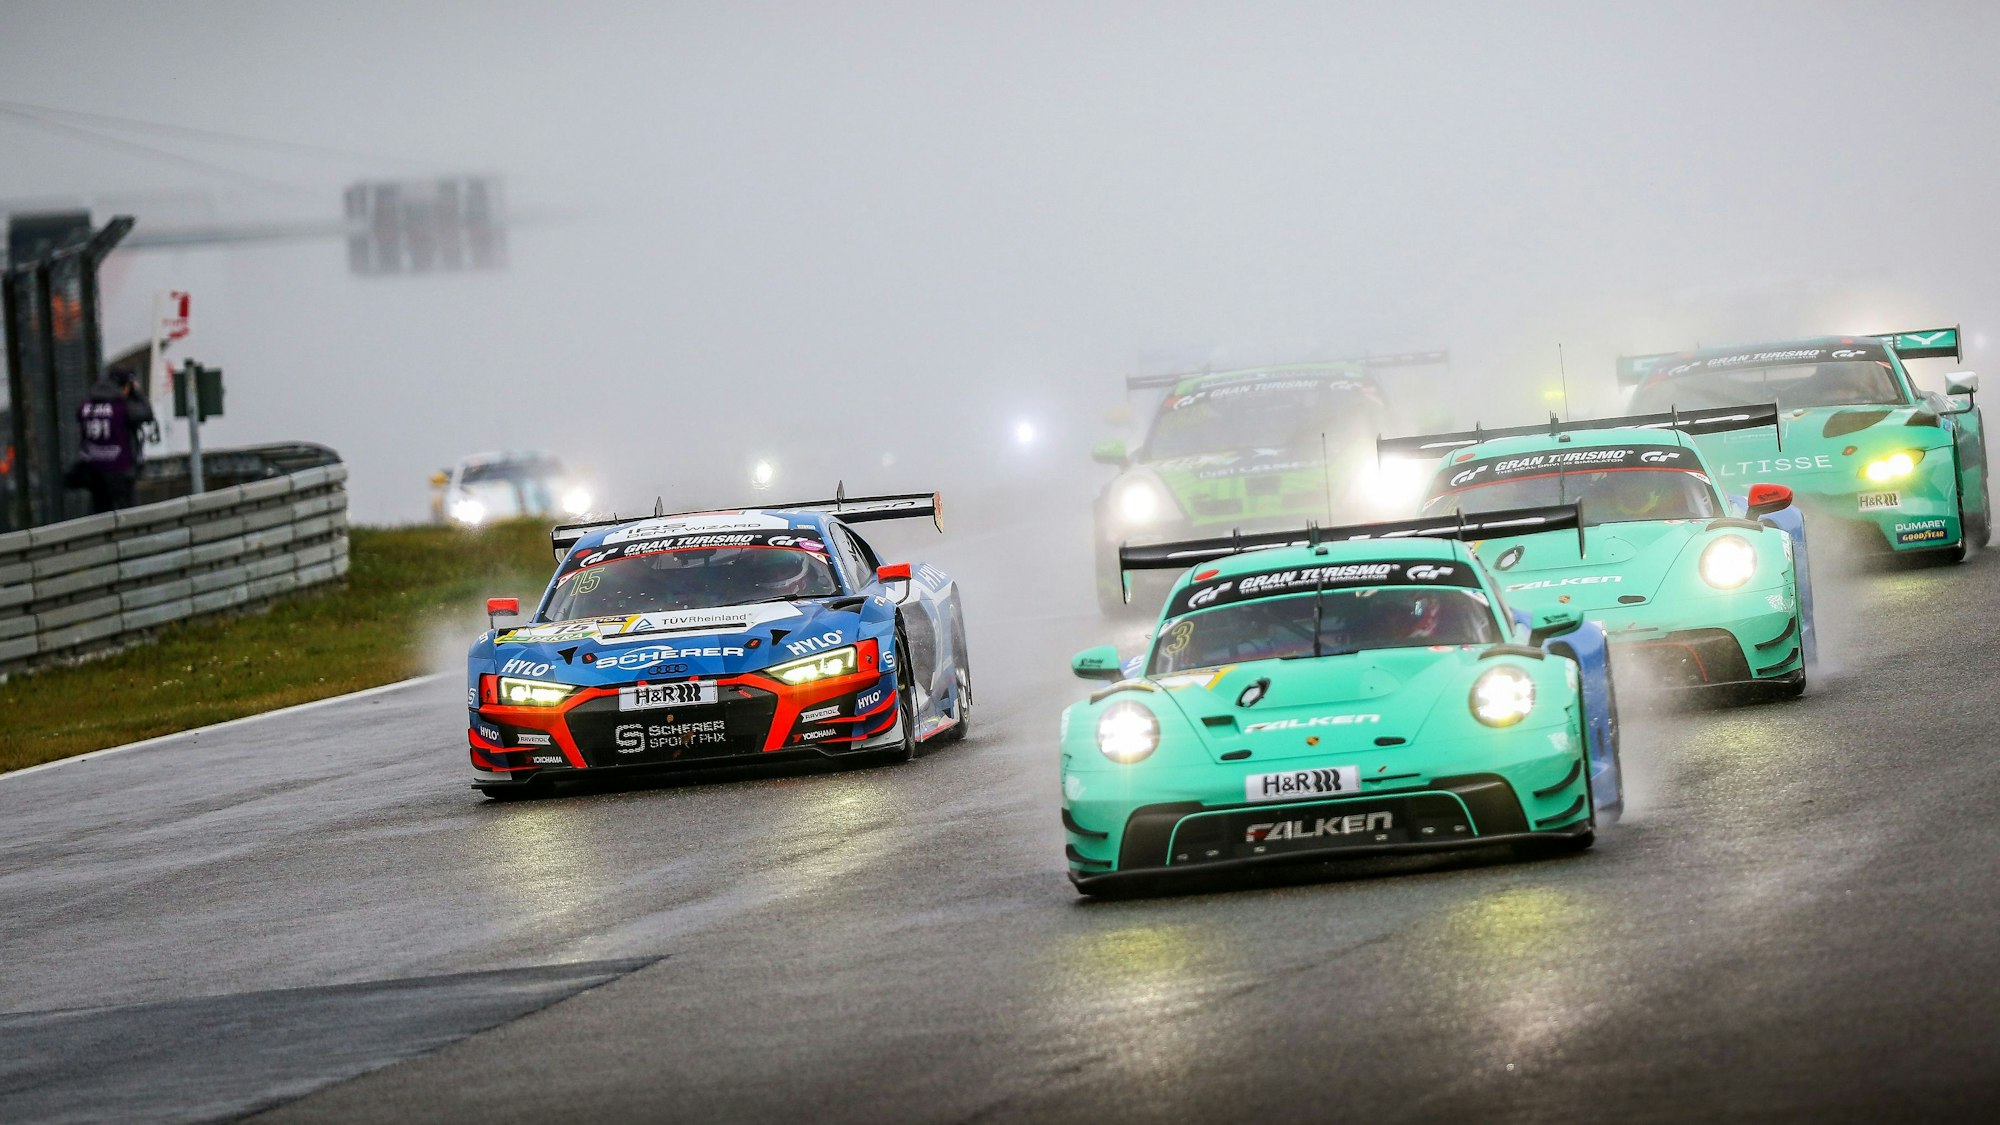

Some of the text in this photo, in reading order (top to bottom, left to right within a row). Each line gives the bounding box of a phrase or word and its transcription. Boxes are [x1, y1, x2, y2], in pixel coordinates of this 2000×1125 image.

[1707, 349, 1820, 366] GRAN TURISMO
[1210, 386, 1249, 398] GRAN
[1254, 380, 1318, 391] TURISMO
[1495, 450, 1626, 471] GRAN TURISMO
[685, 523, 760, 532] WIZARD
[1895, 519, 1946, 531] DUMAREY
[624, 534, 754, 552] GRAN TURISMO
[570, 567, 606, 597] 15
[1239, 563, 1391, 590] GRAN TURISMO
[1505, 575, 1622, 592] FALKEN
[786, 632, 842, 656] HYLO
[1166, 621, 1195, 654] 3
[596, 646, 744, 669] SCHERER
[501, 659, 550, 677] HYLO
[635, 685, 677, 705] H&R
[857, 691, 880, 709] HYLO
[805, 708, 837, 720] RAVENOL
[1244, 713, 1381, 733] FALKEN
[480, 726, 499, 740] HYLO
[648, 720, 725, 736] SCHERER
[802, 728, 837, 740] YOKOHAMA
[649, 733, 726, 748] SPOT PHX
[532, 756, 562, 764] YOKOHAMA
[1263, 772, 1311, 796] H&R
[1245, 810, 1393, 842] FALKEN
